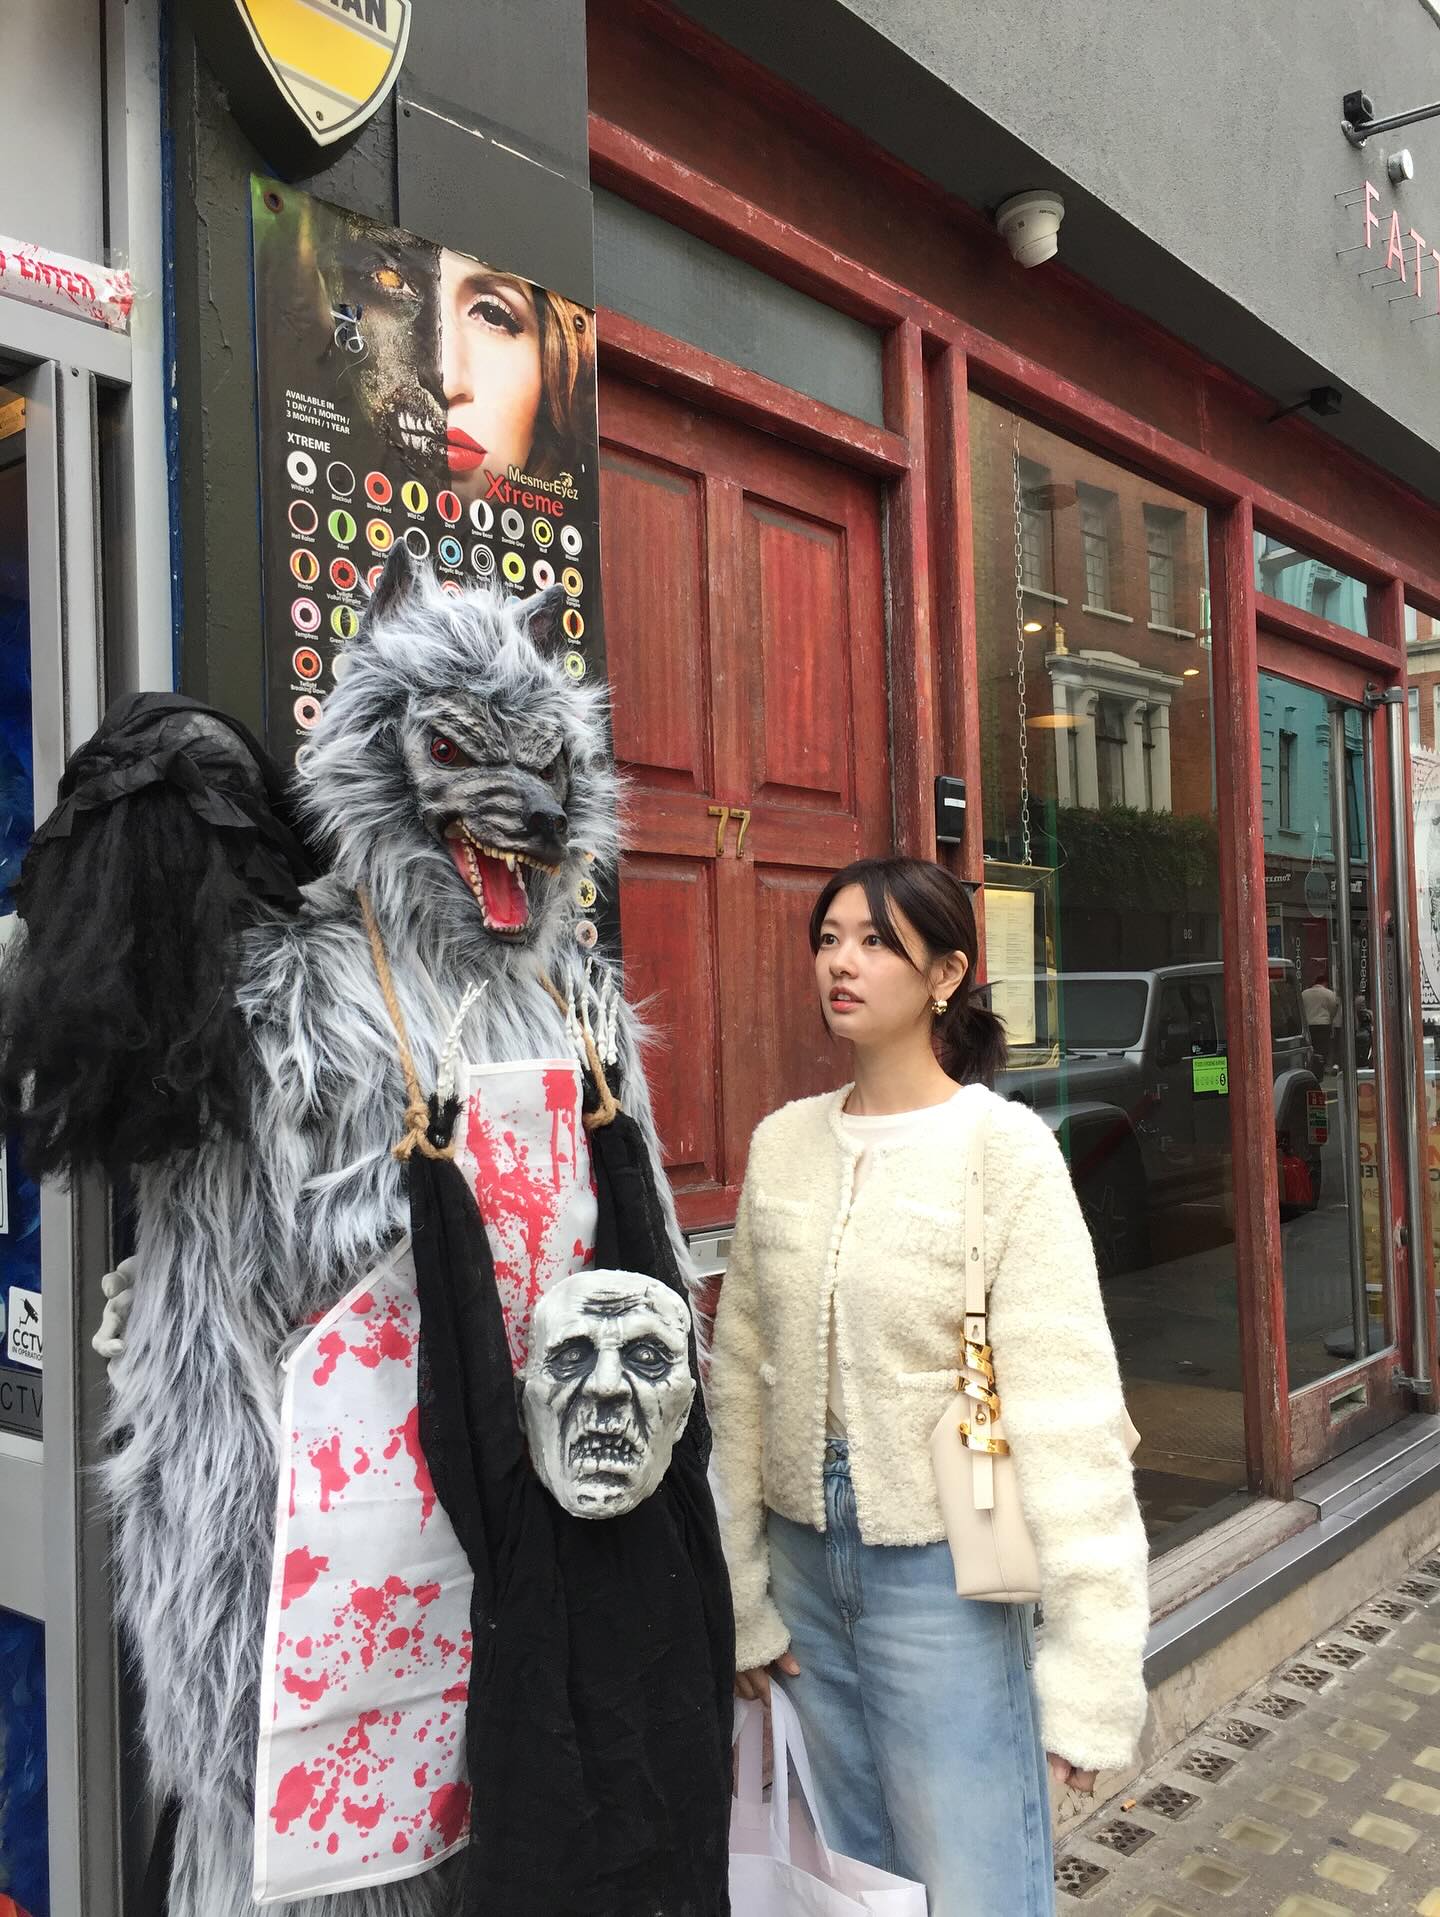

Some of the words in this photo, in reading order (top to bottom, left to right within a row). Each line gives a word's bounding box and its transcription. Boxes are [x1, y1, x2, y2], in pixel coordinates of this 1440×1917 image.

[330, 0, 387, 33] AN
[286, 389, 326, 408] AVAILABLE
[326, 400, 335, 410] IN
[286, 400, 290, 408] 1
[292, 401, 307, 412] DAY
[313, 407, 317, 415] 1
[319, 409, 346, 423] MONTH
[286, 410, 291, 418] 3
[292, 411, 320, 426] MONTH
[326, 421, 330, 429] 1
[331, 422, 350, 435] YEAR
[287, 431, 331, 453] XTREME
[291, 483, 304, 492] White
[484, 470, 564, 518] Xtreme
[508, 465, 579, 500] MesmerEyez
[708, 806, 751, 858] 77
[13, 1328, 43, 1354] CCTV
